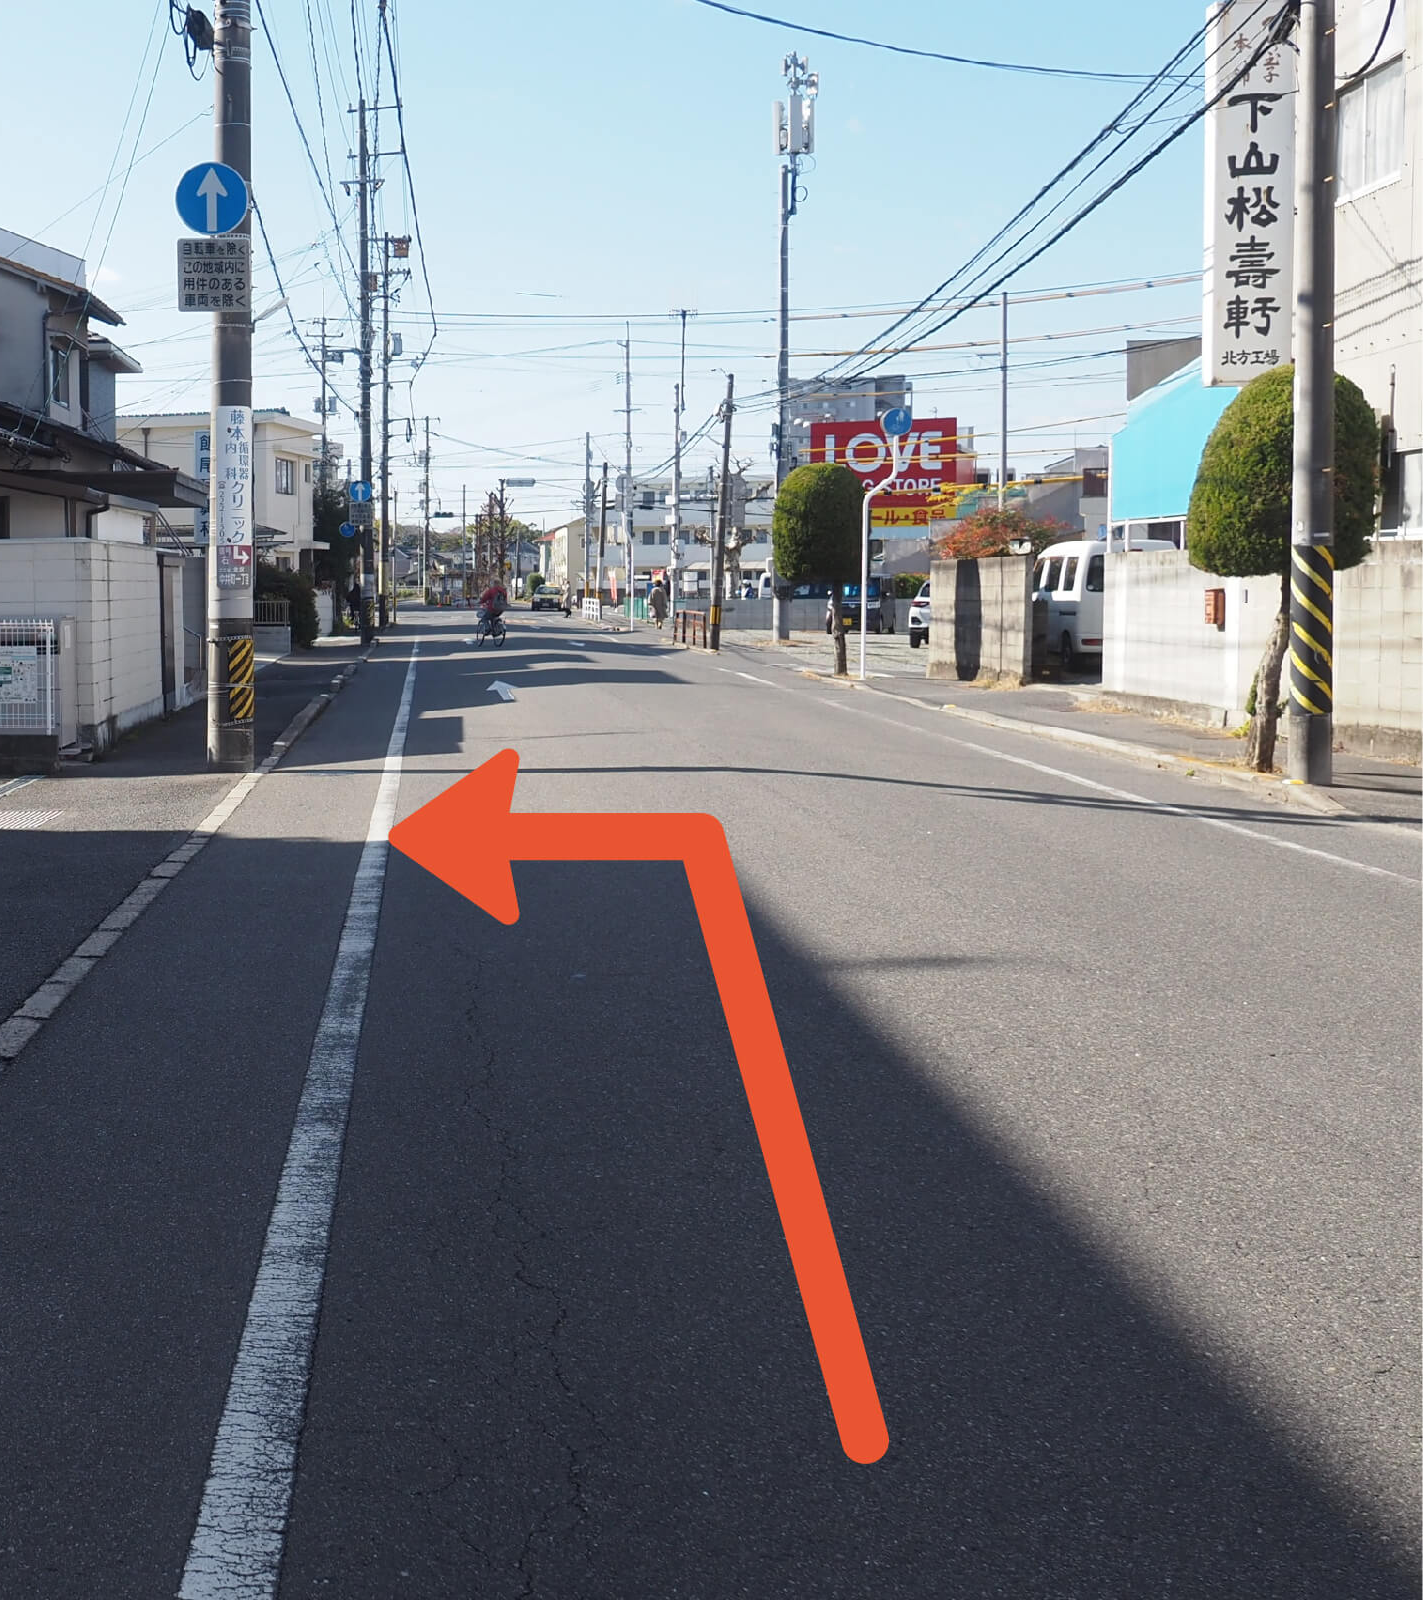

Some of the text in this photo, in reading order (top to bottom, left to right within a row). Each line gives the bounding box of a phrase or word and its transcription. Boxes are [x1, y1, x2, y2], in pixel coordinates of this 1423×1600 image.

[183, 242, 246, 256] 自転車を除く
[183, 261, 245, 275] この地域内に
[183, 277, 246, 292] 用件のある
[184, 293, 246, 308] 車両を除く
[1221, 350, 1281, 367] 北方工場
